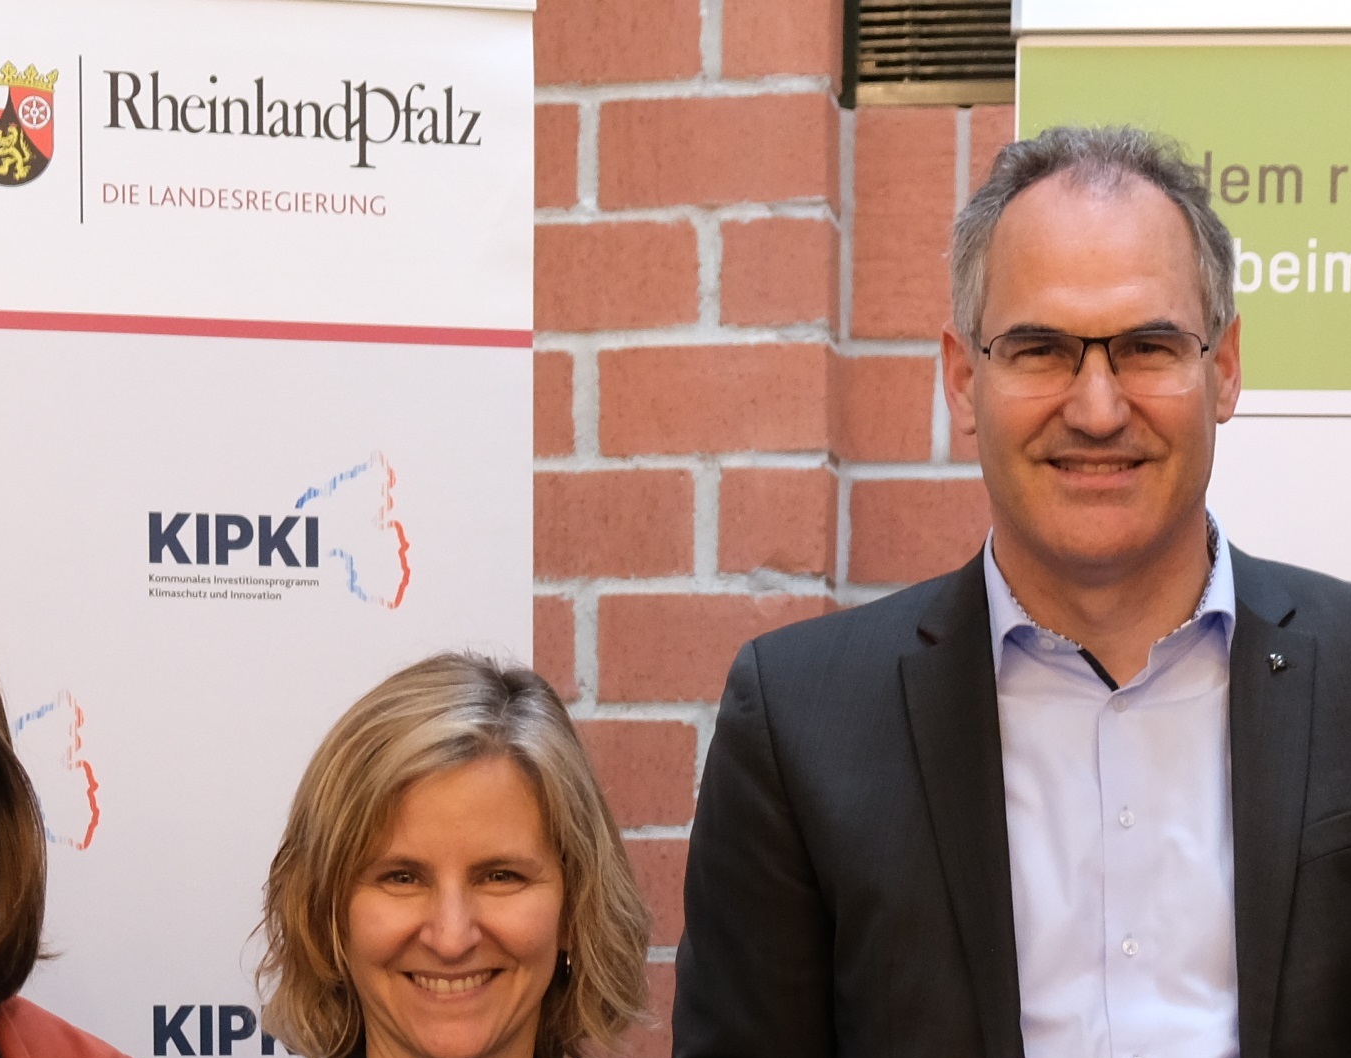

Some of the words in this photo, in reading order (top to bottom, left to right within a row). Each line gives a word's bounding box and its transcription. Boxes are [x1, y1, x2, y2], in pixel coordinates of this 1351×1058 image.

[103, 71, 482, 168] RheinlandPfalz
[102, 183, 139, 205] DIE
[149, 185, 386, 215] LANDESREGIERUNG
[149, 512, 318, 568] KIPKI
[149, 574, 211, 584] Kommunales
[214, 576, 319, 588] Investitionsprogramm
[149, 589, 207, 599] Klimaschutz
[210, 590, 227, 599] und
[231, 591, 281, 600] Innovation
[153, 1005, 298, 1056] KIP
